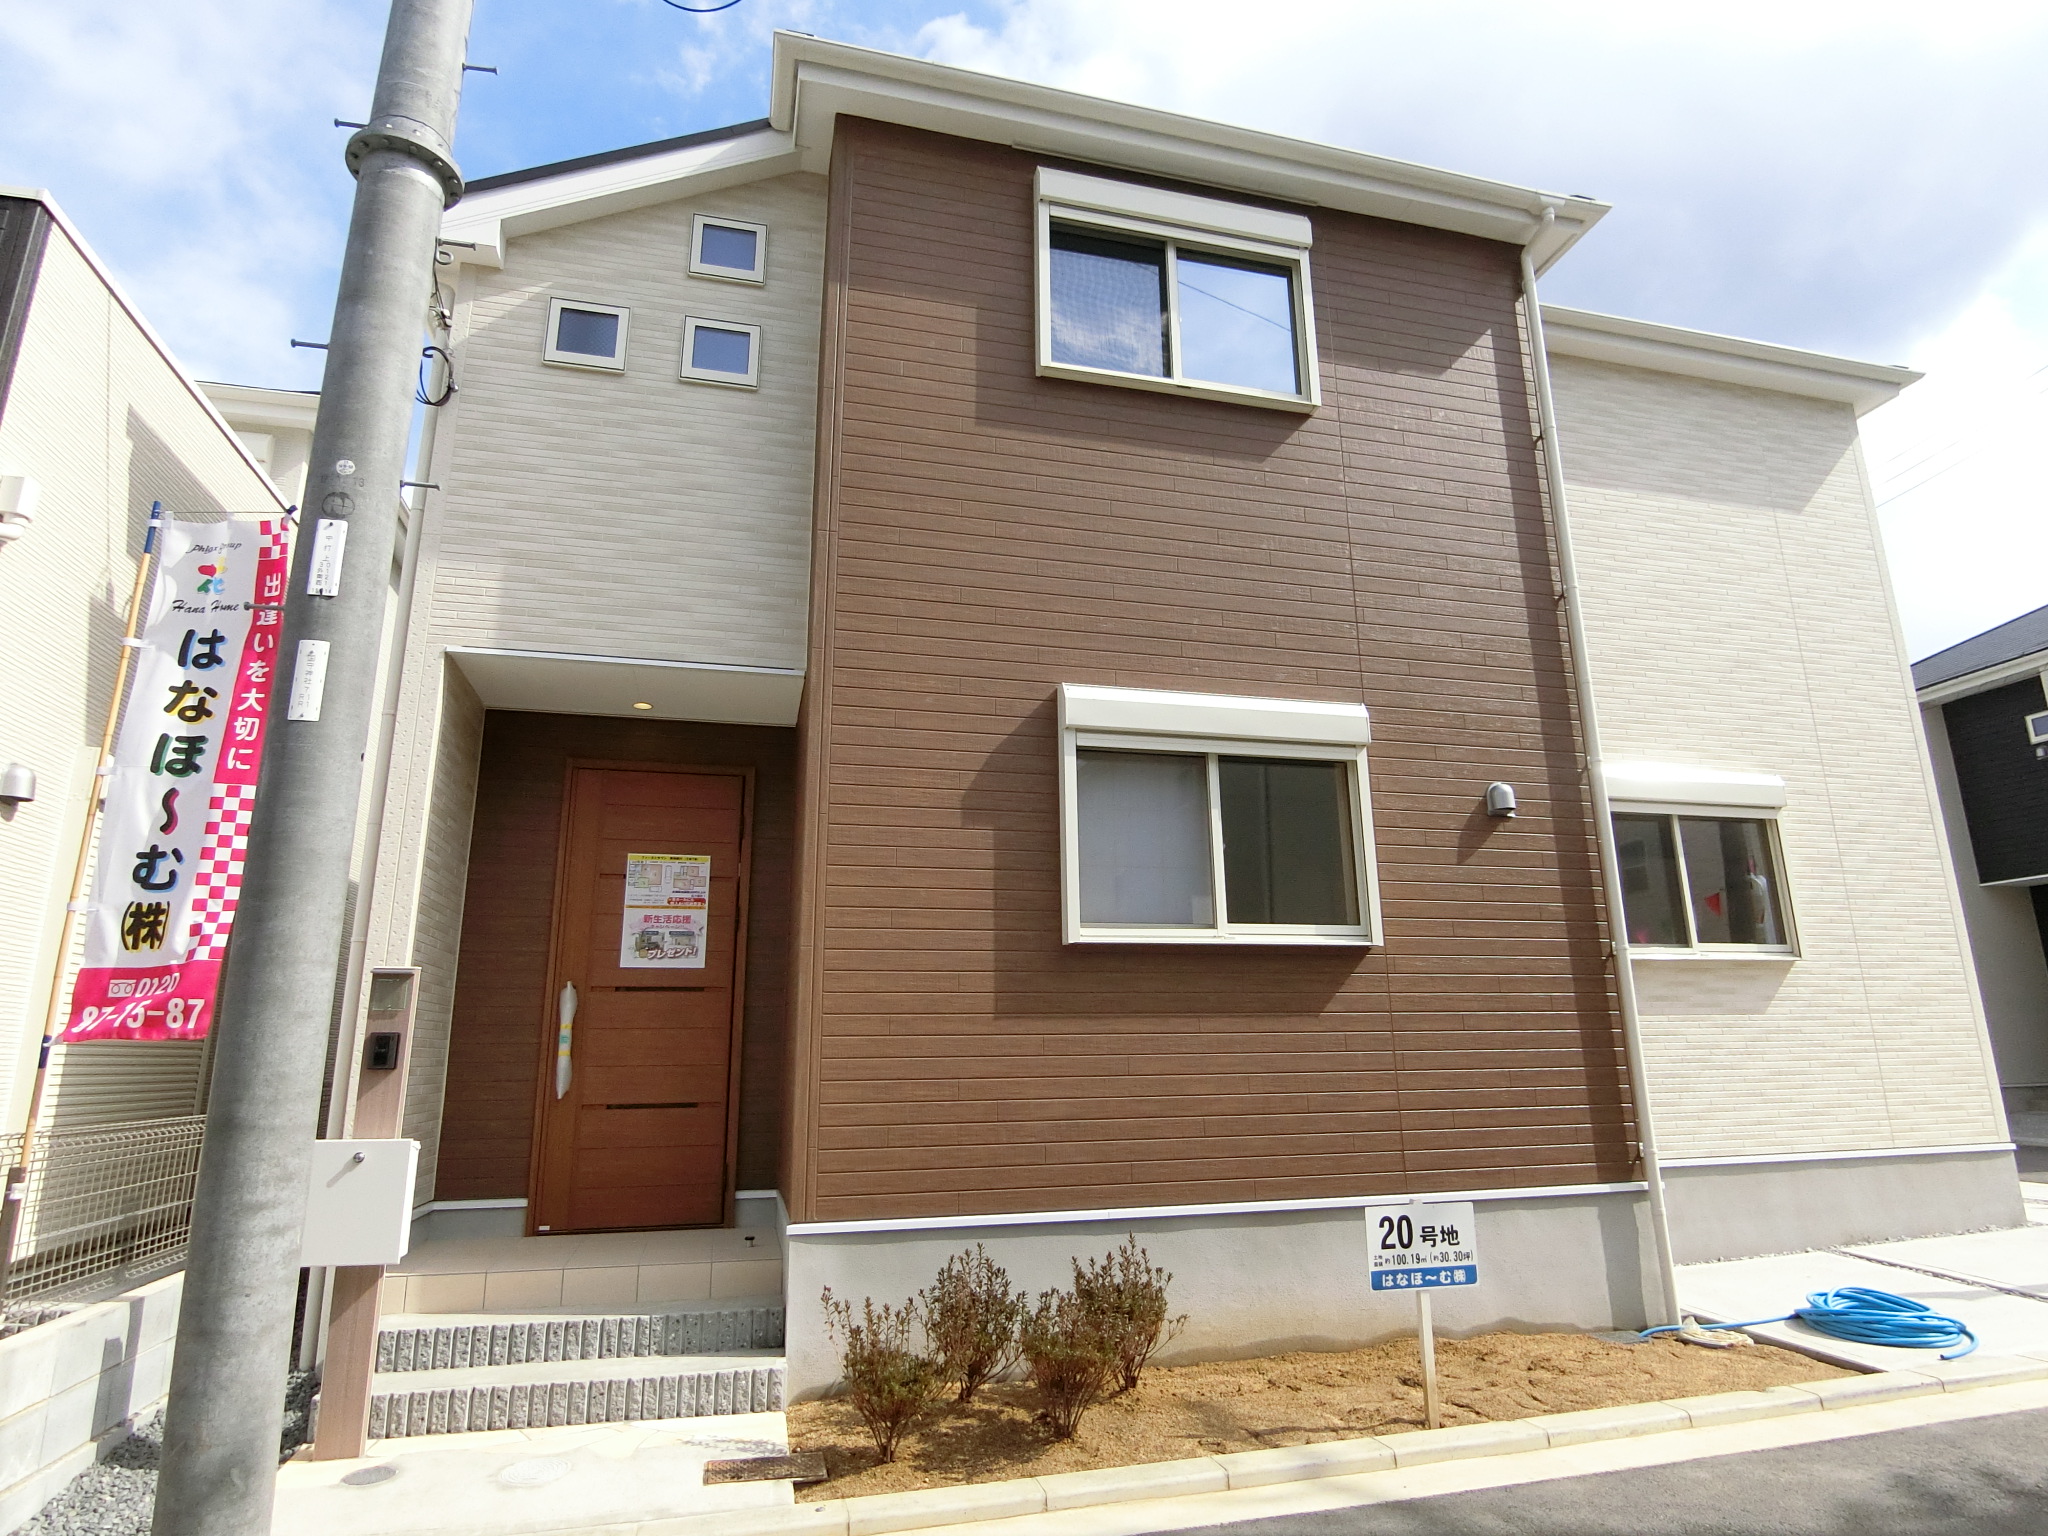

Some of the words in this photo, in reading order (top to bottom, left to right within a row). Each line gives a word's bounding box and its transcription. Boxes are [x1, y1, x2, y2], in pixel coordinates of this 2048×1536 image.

[172, 599, 206, 614] Hana
[211, 599, 240, 613] Home
[643, 914, 692, 924] 新生活応援
[135, 972, 180, 998] 0120
[71, 998, 206, 1034] 97-15-87
